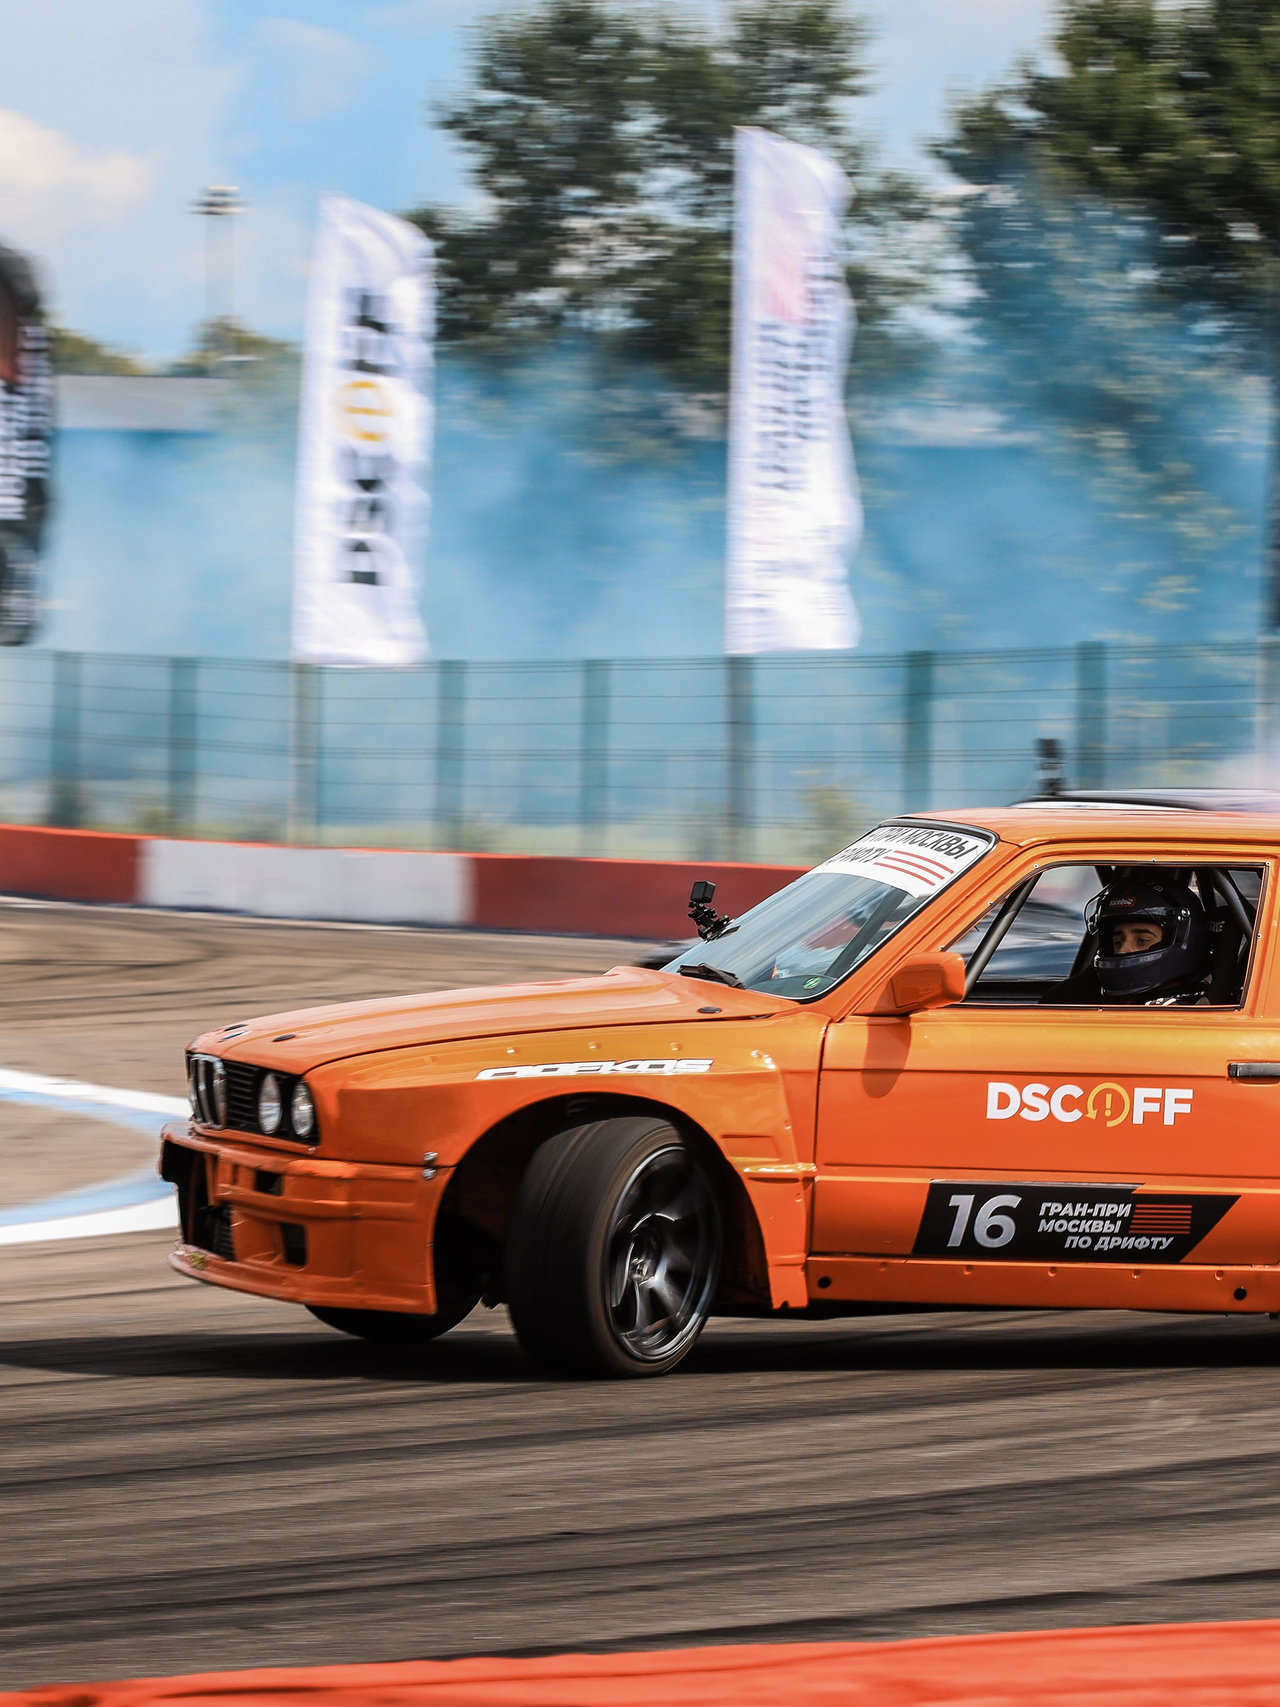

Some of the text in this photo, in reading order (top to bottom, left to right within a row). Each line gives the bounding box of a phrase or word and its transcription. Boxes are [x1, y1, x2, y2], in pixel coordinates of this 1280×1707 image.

[1039, 1202, 1132, 1218] ГРАН-ПРИ
[946, 1194, 1022, 1249] 16
[1038, 1219, 1122, 1234] МОСКВЫ
[1064, 1235, 1174, 1251] ПО ДРИФТУ
